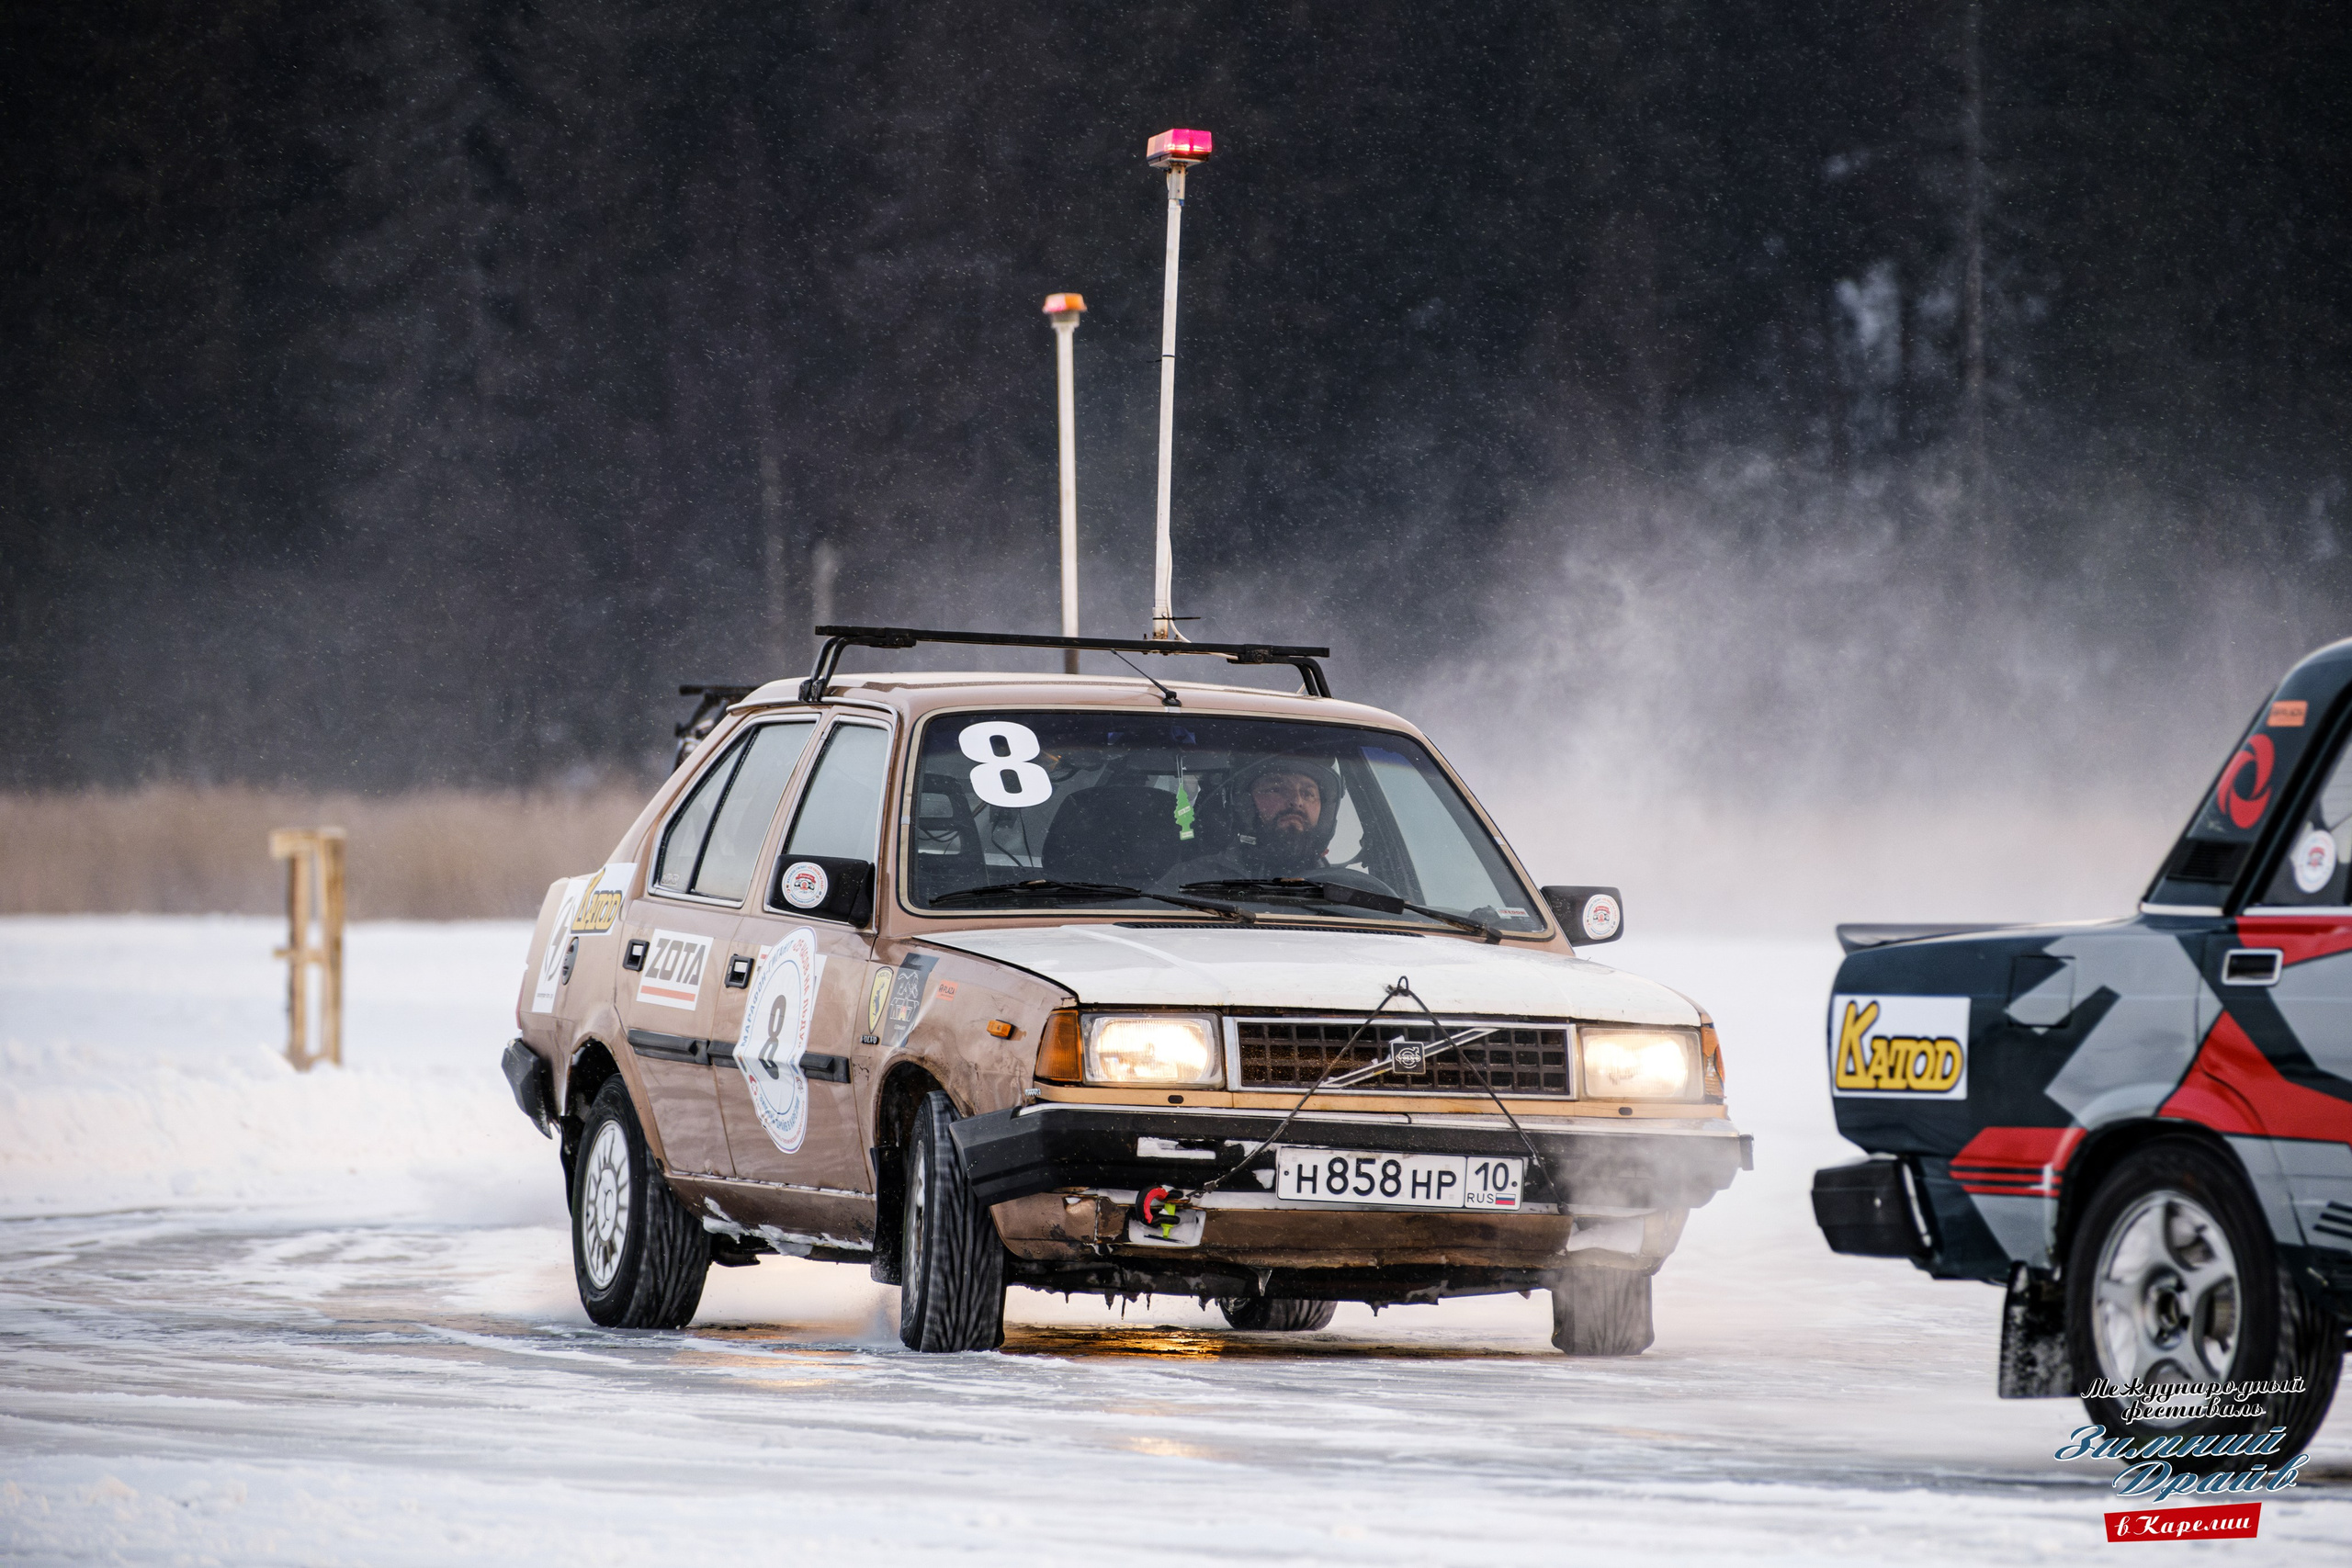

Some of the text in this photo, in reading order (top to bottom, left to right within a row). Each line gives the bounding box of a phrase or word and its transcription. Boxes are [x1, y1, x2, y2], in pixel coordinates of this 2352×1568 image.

[958, 721, 1053, 808] 8
[645, 938, 706, 987] ZOTA
[758, 994, 787, 1080] 8
[1836, 999, 1964, 1093] KATOD
[1467, 1192, 1495, 1204] RUS
[1475, 1162, 1510, 1192] 10
